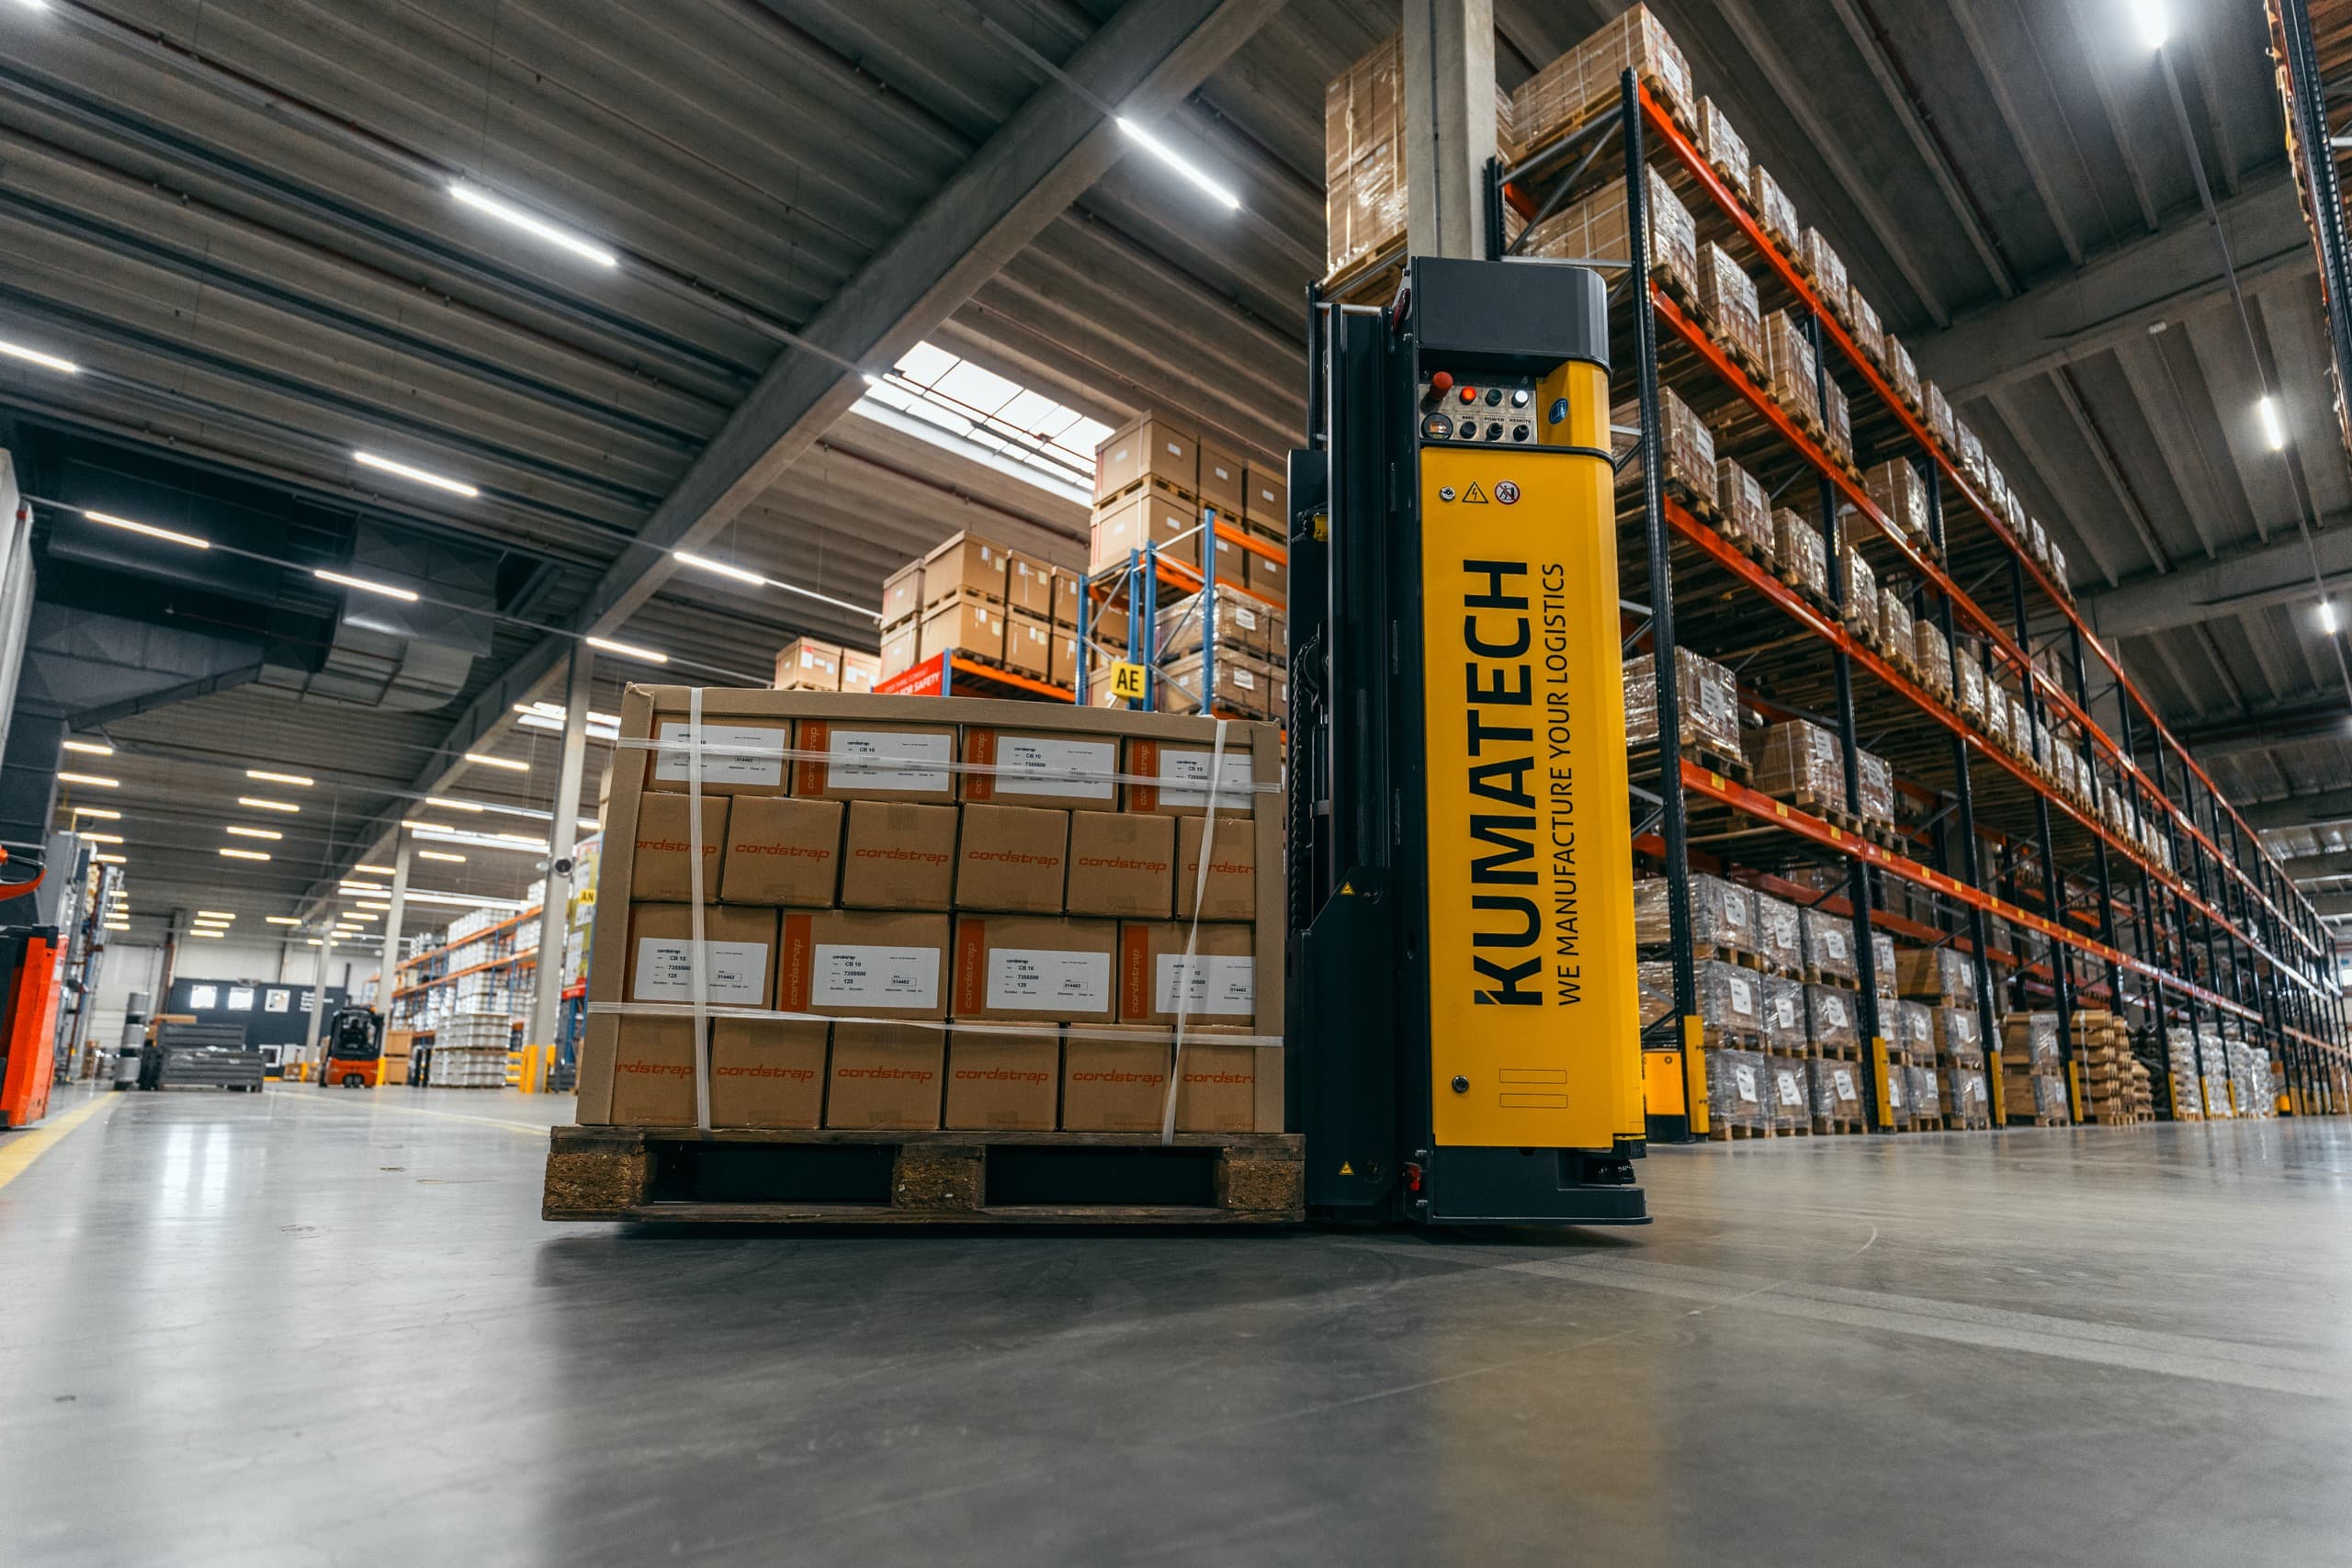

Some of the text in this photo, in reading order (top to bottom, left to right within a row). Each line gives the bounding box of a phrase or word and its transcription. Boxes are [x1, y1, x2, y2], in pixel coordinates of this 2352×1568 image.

[913, 671, 941, 693] SAFETY
[1116, 668, 1139, 692] AE
[808, 728, 820, 790] cordtrap
[976, 733, 988, 794] corstrap
[1141, 746, 1151, 806] corstrap
[1463, 559, 1544, 1006] KUMATECH
[1542, 563, 1581, 1007] WE MANUFACTURE YOUR LOGISTICS
[634, 838, 717, 857] ordstrp
[735, 841, 831, 862] cordstrap
[855, 846, 949, 866] cordstrap
[968, 851, 1059, 868] cordstrap
[1079, 856, 1168, 874] cordstrap
[581, 891, 594, 902] AN
[791, 939, 804, 1006] cordstrap
[966, 942, 978, 1009] cordstrap
[1132, 948, 1143, 1014] cordstrap
[717, 1064, 814, 1083] cordstrap
[838, 1066, 933, 1084] cordstrap
[956, 1067, 1049, 1086] cordstrap
[1072, 1069, 1164, 1088] cordstrap
